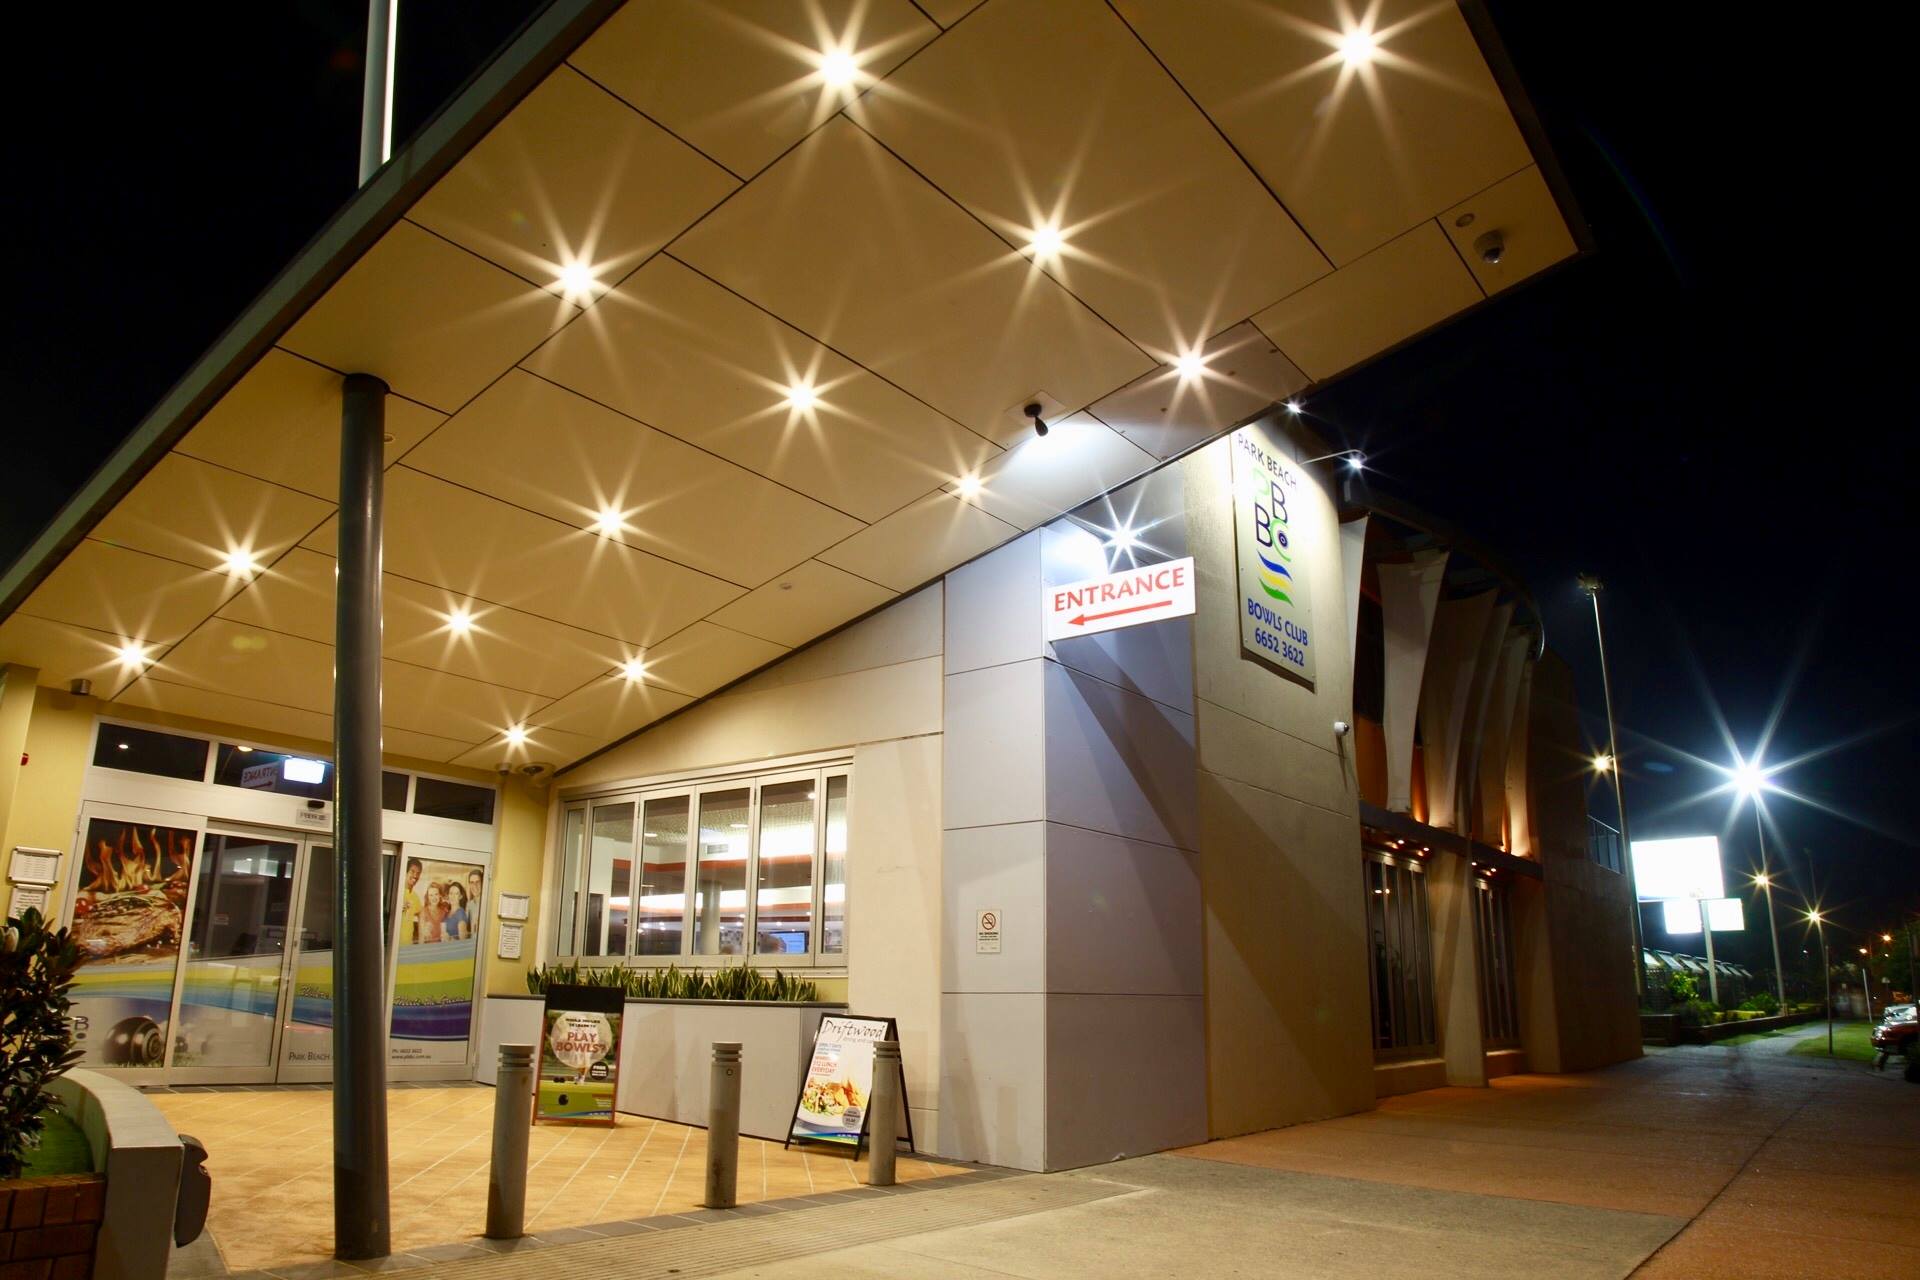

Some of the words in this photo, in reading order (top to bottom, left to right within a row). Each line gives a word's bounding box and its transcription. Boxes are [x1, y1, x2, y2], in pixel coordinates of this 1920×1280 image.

[1238, 433, 1264, 466] PARK
[1267, 455, 1297, 490] BEACH
[1054, 566, 1185, 612] ENTRANCE
[1247, 597, 1282, 632] BOWLS
[1284, 620, 1308, 646] CLUB
[1255, 627, 1280, 654] 6652
[1282, 640, 1305, 667] 3622
[555, 1041, 607, 1054] BOWLS?
[567, 1031, 597, 1042] PLAY
[821, 1019, 886, 1041] Driftwood
